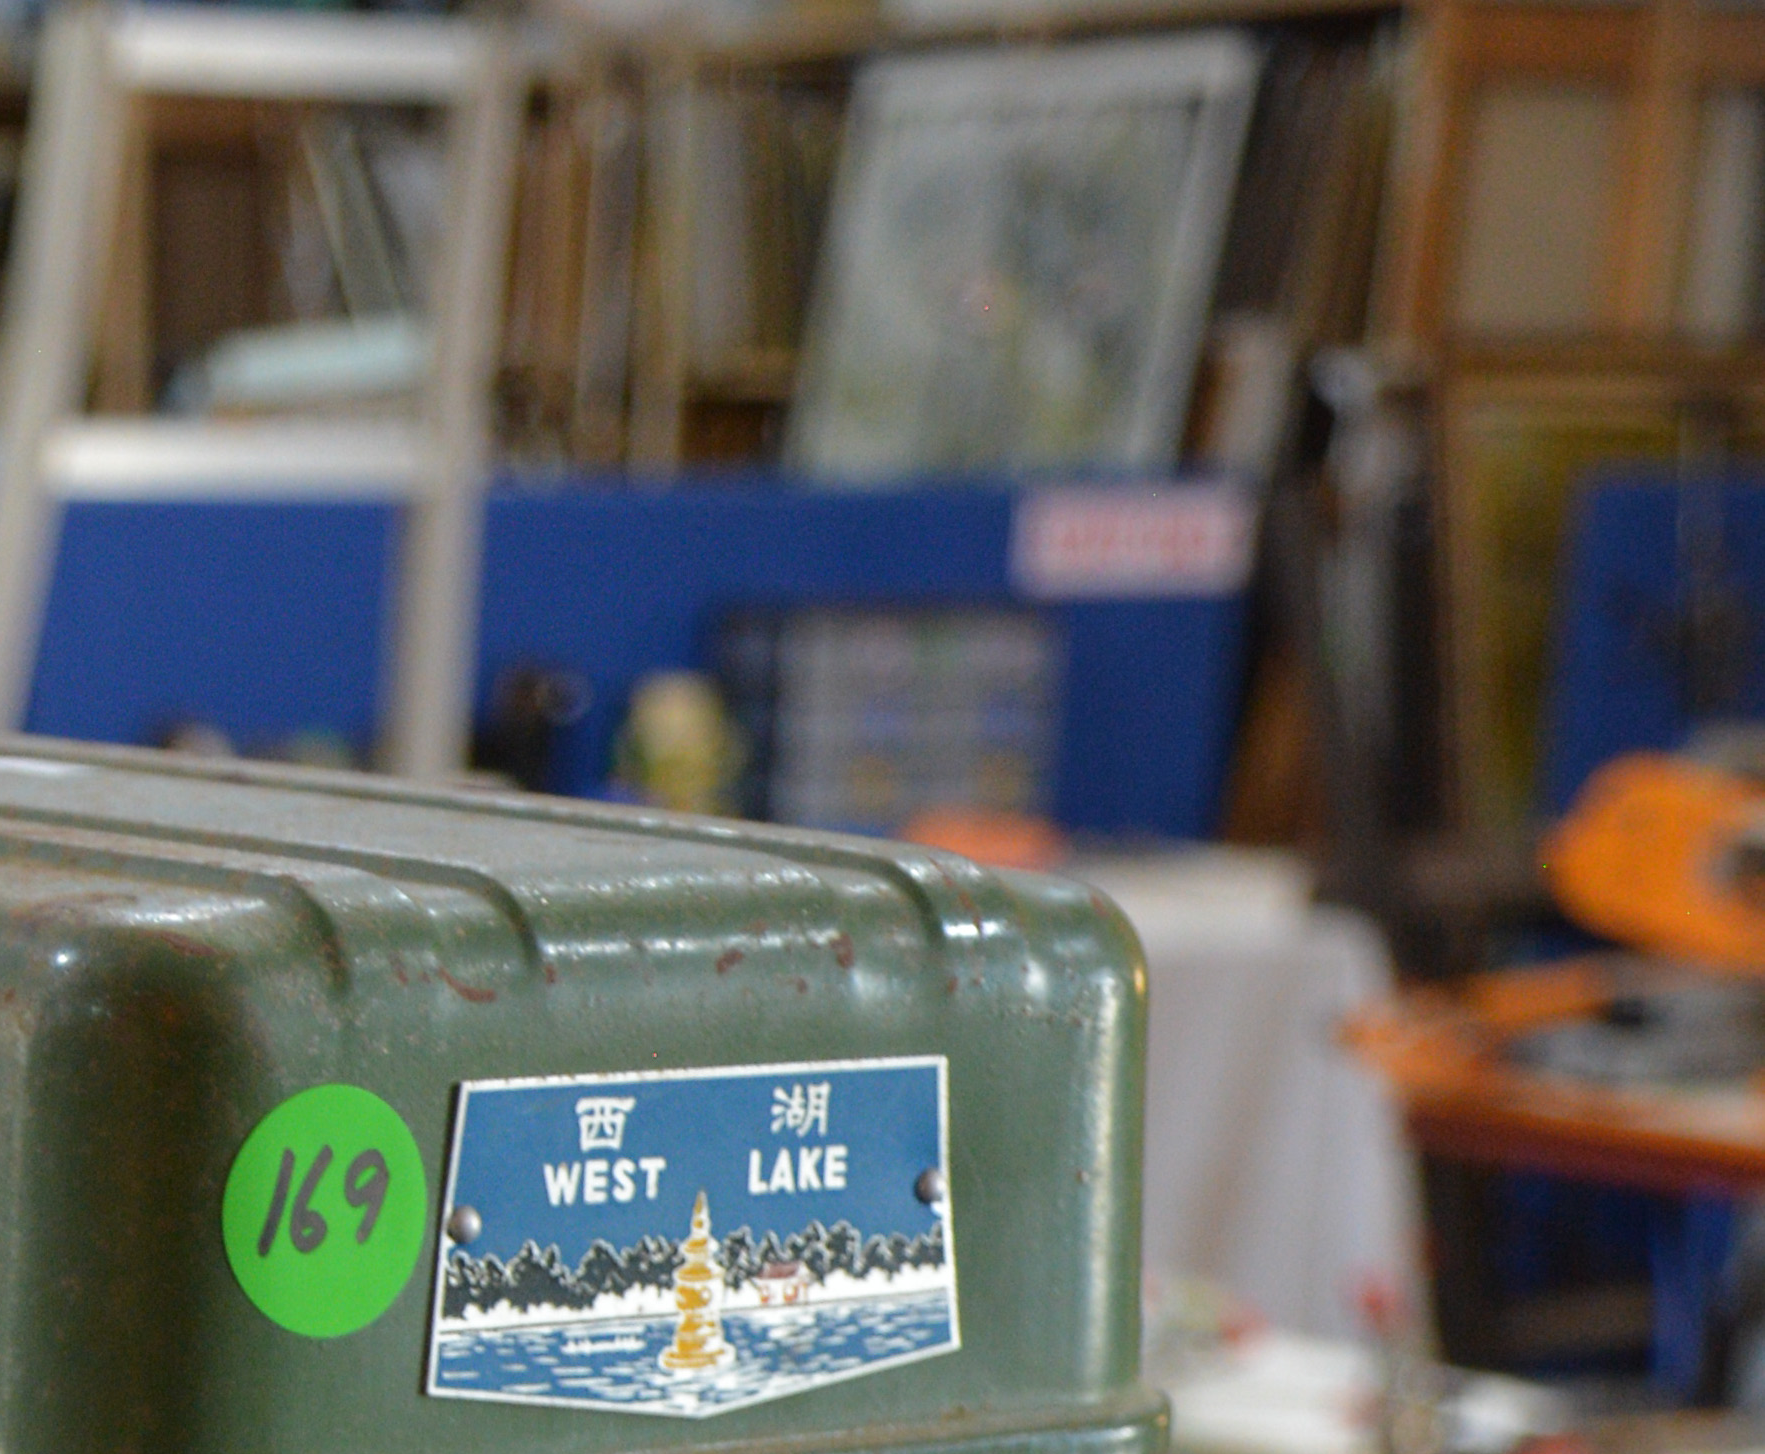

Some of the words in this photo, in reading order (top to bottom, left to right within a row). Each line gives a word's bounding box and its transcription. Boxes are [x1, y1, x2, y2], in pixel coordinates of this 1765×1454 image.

[576, 1096, 636, 1152] 西
[771, 1081, 832, 1138] 湖
[257, 1143, 391, 1258] 169
[543, 1157, 667, 1208] WEST
[748, 1145, 849, 1196] LAKE
